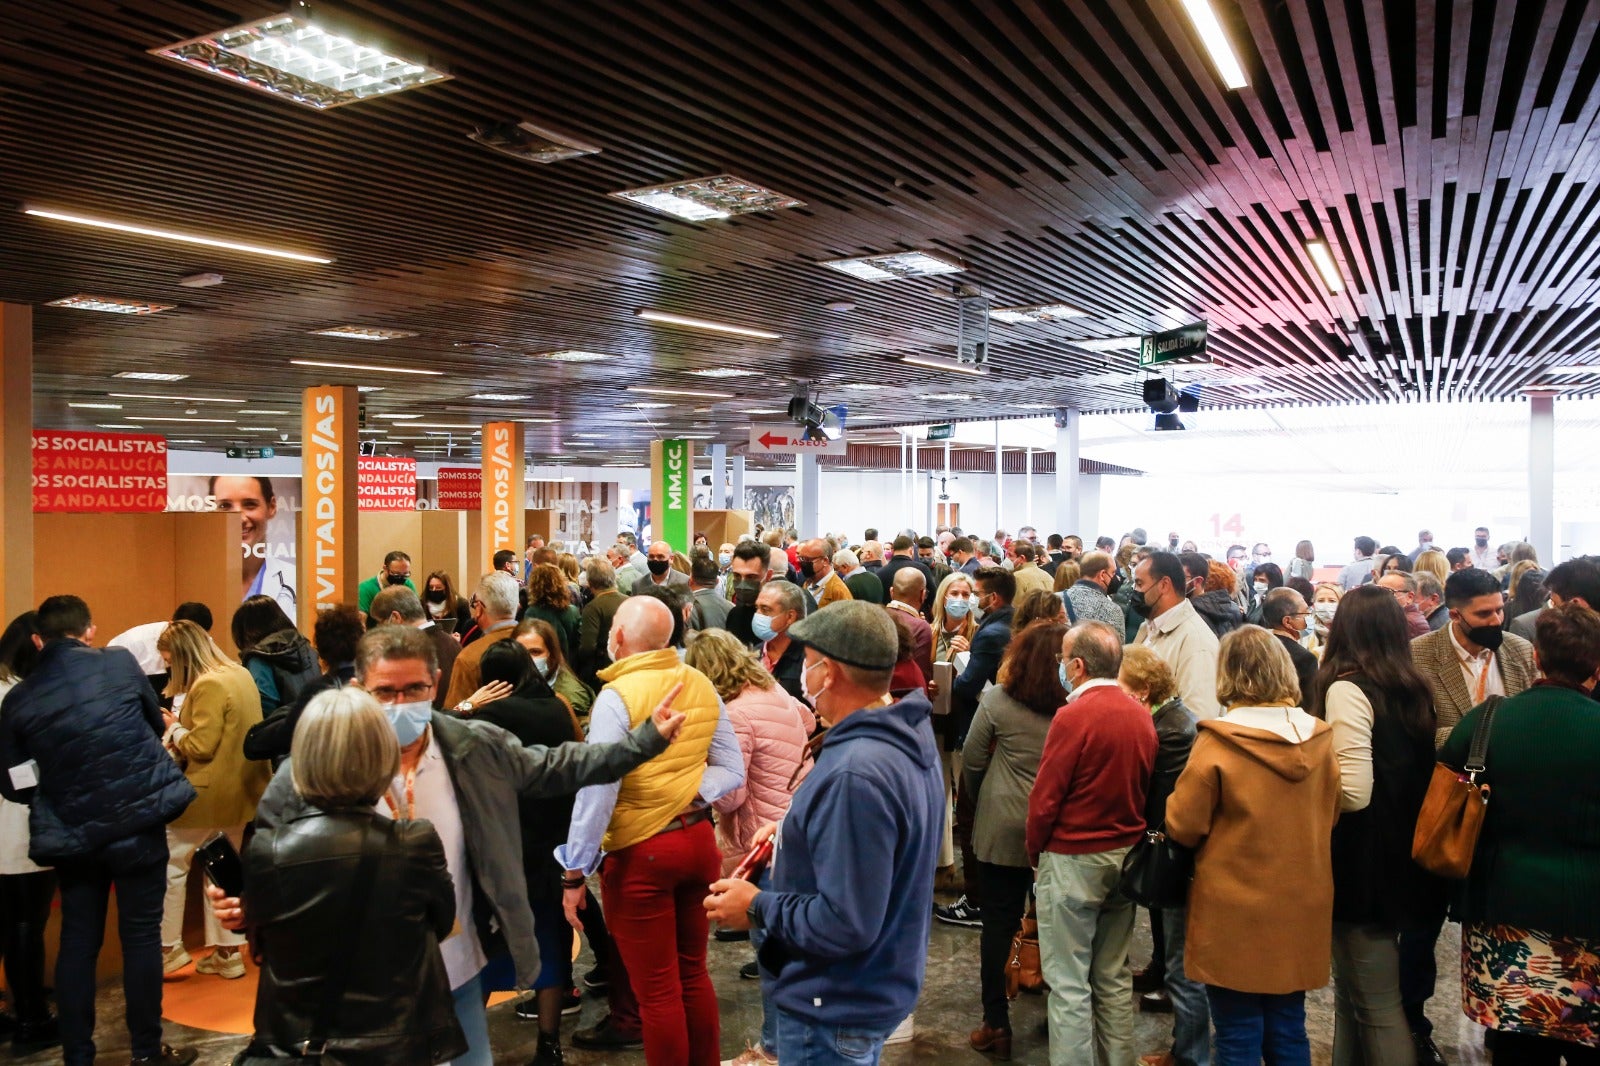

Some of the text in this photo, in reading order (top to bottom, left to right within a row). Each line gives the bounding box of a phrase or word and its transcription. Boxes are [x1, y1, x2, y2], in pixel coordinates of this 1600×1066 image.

[1157, 336, 1191, 354] SALIDA EXIT
[52, 437, 167, 454] SOCIALISTAS
[53, 456, 166, 472] ANDALUCÍA
[53, 475, 167, 489] SOCIALISTAS
[438, 472, 467, 480] SOMOS
[668, 445, 682, 510] MM.CC.
[438, 491, 467, 499] SOMOS
[491, 428, 512, 553] TADOS/AS
[56, 492, 167, 507] ANDALUCÍA
[1209, 513, 1245, 538] 14
